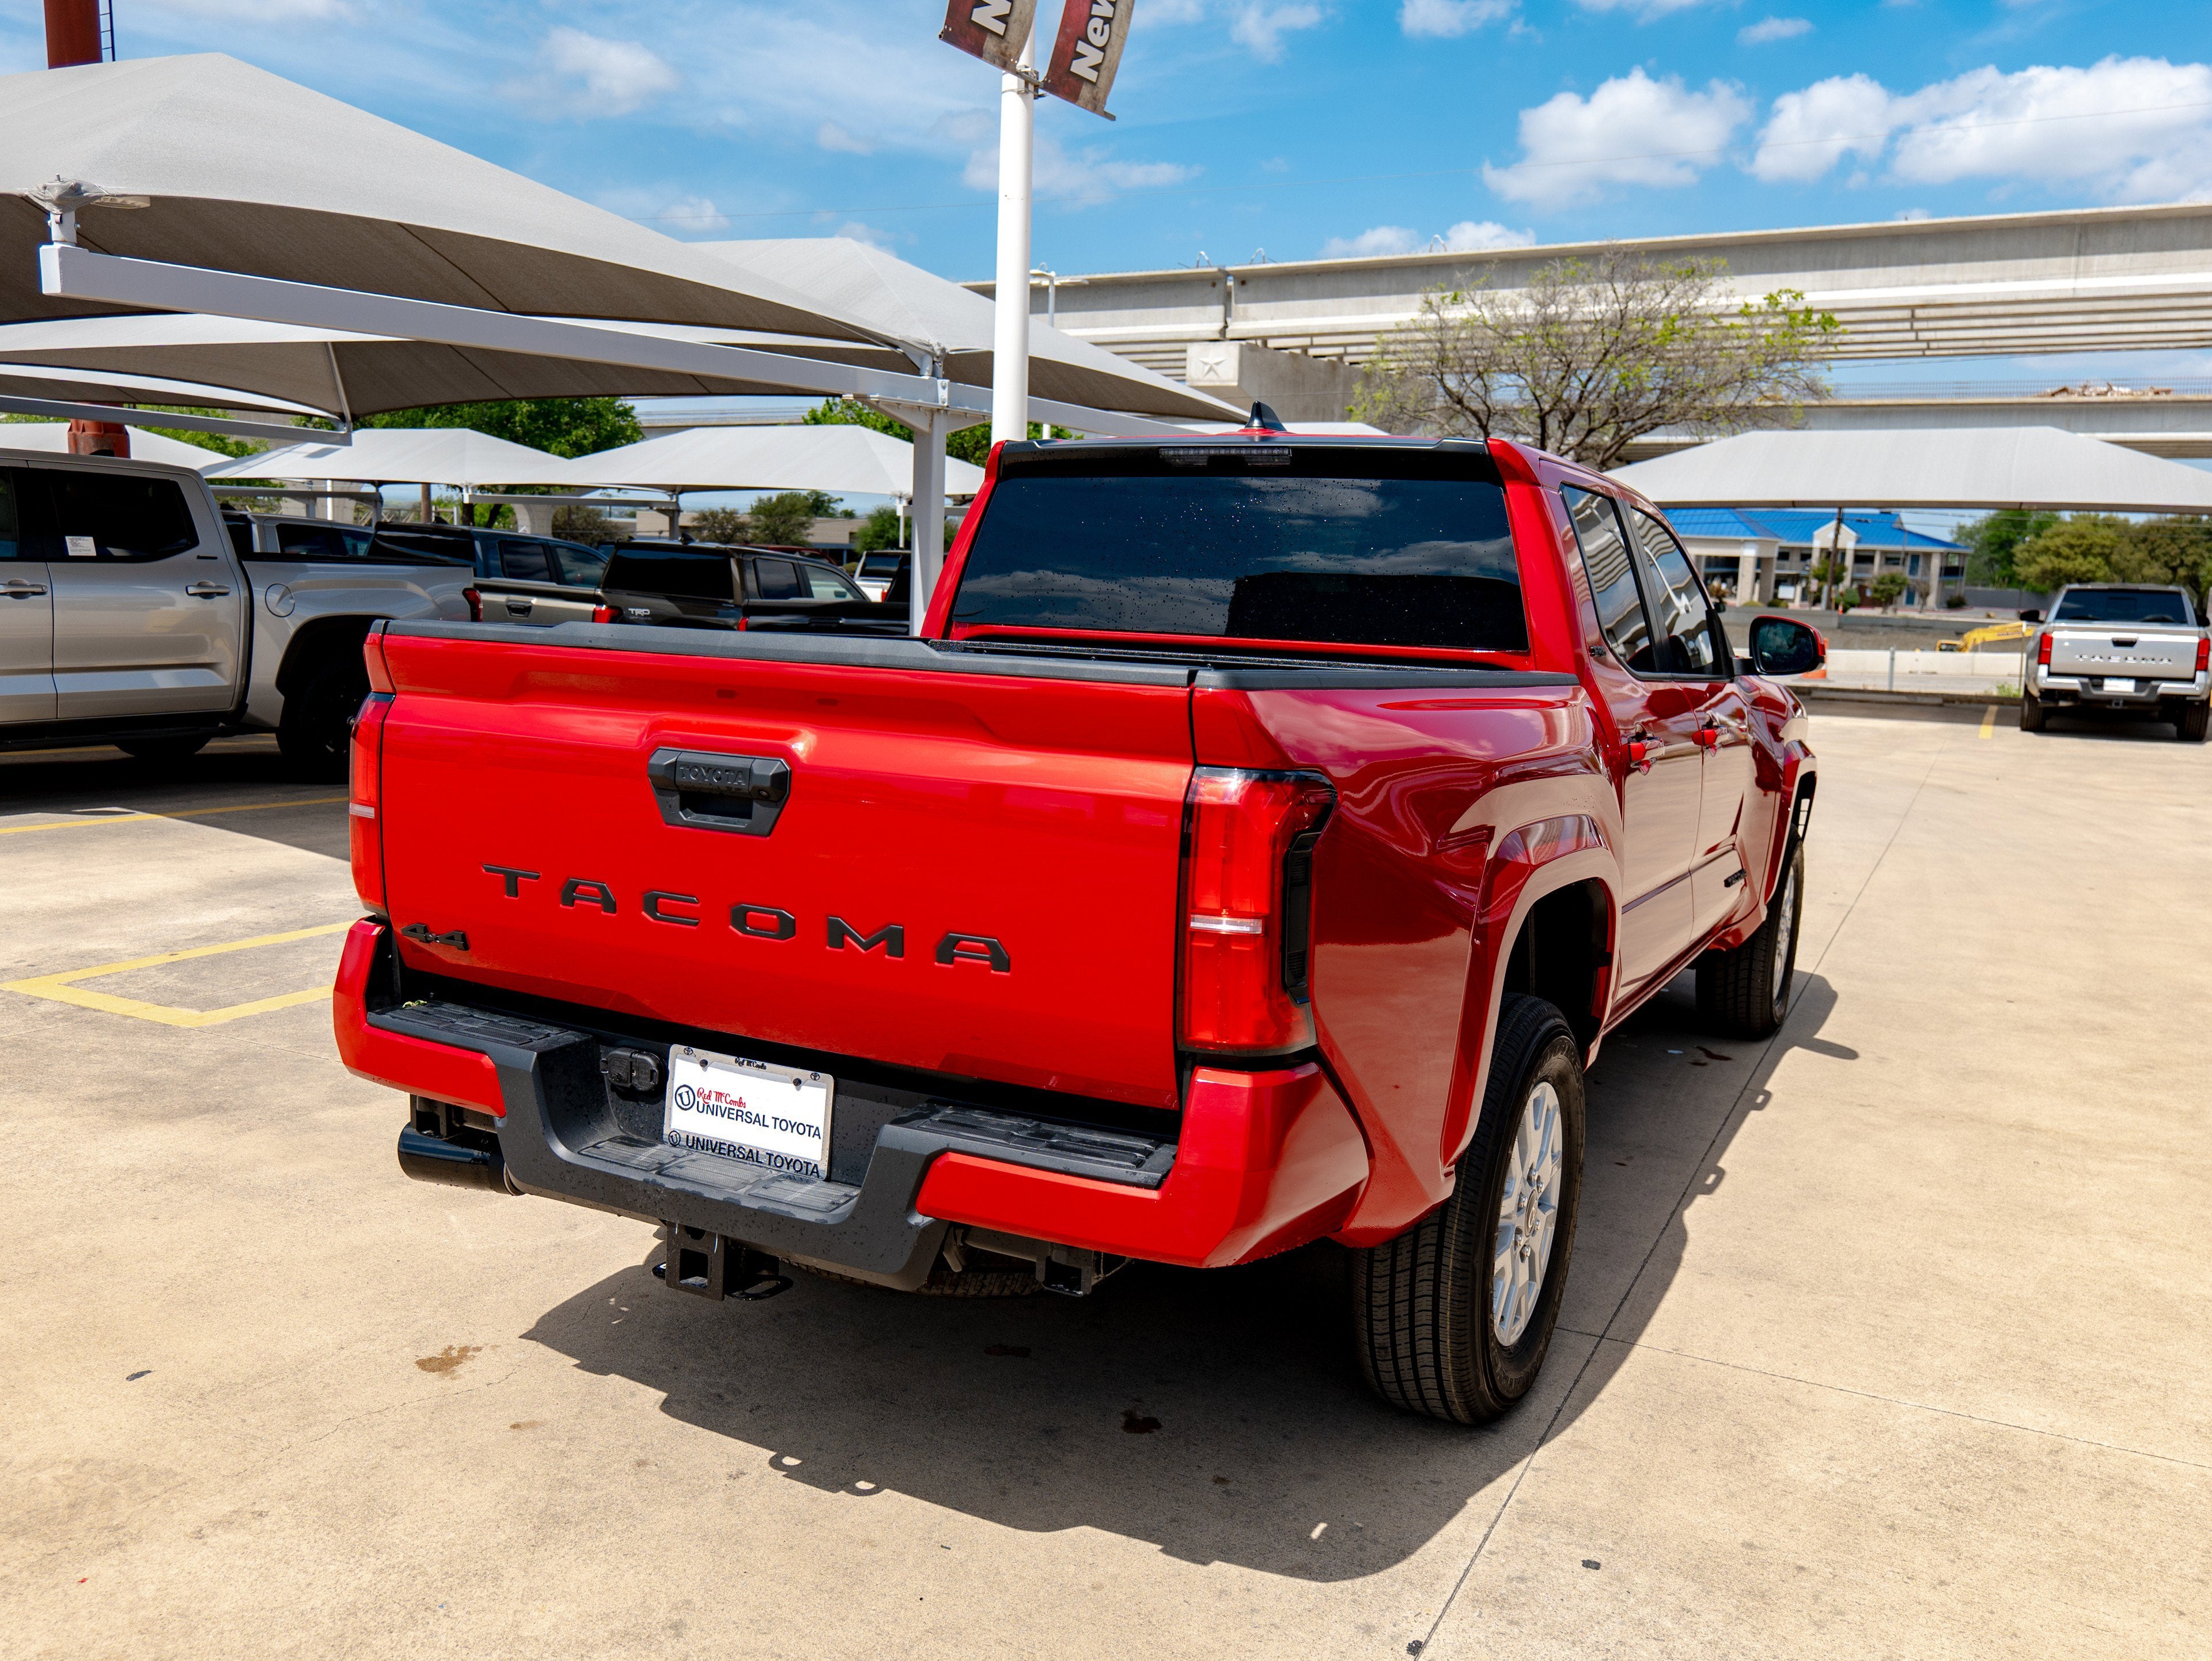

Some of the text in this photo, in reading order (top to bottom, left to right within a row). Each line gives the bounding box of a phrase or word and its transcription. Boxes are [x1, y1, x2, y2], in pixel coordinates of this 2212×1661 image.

[628, 608, 650, 616] TRD
[679, 764, 746, 786] TOYOTA
[482, 863, 1010, 973] TACOMA
[697, 1087, 746, 1108] Red McCombs
[696, 1100, 821, 1140] UNIVERSAL TOYOTA
[685, 1134, 820, 1179] UNIVERSAL TOYOTA
